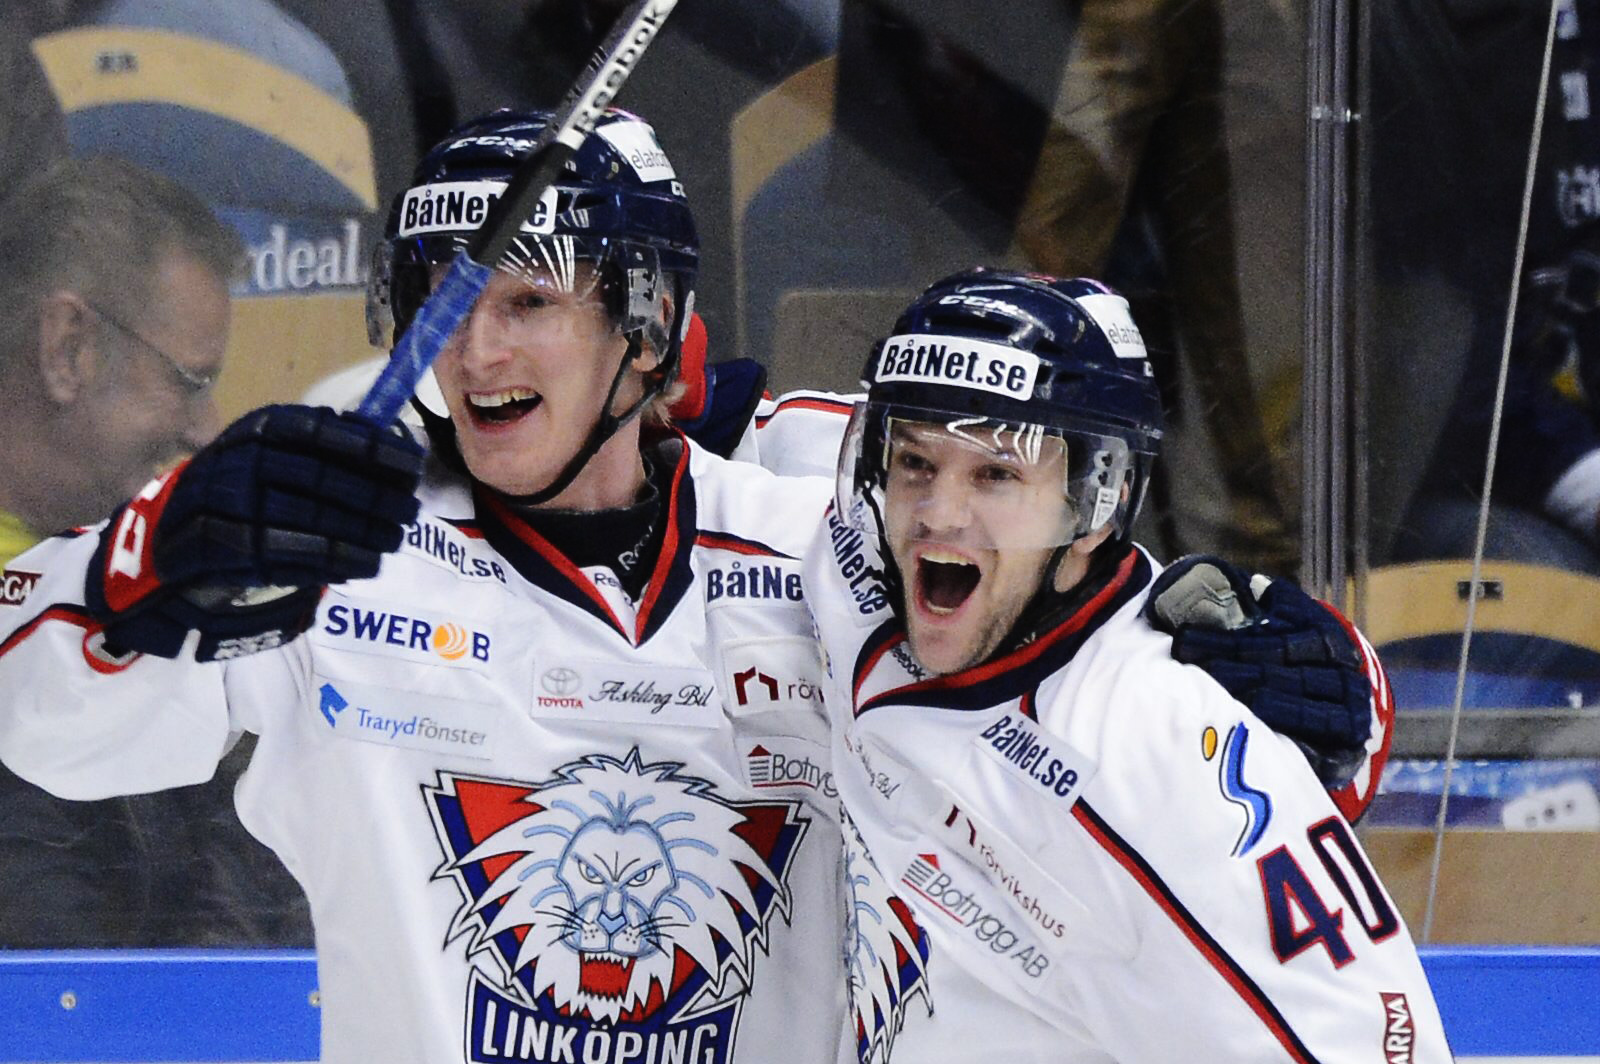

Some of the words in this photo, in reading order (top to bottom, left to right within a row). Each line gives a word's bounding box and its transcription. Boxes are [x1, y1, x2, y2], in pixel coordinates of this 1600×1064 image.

[881, 338, 1027, 393] BåtNet.se
[357, 707, 487, 746] Trarydfönster
[537, 696, 584, 710] TOYOTA
[675, 684, 714, 708] Bil
[980, 715, 1079, 797] BåtNet.se
[926, 872, 1019, 953] Botrygg
[1010, 945, 1050, 979] AB
[980, 844, 1067, 939] rörvikshus
[1256, 815, 1401, 970] 40
